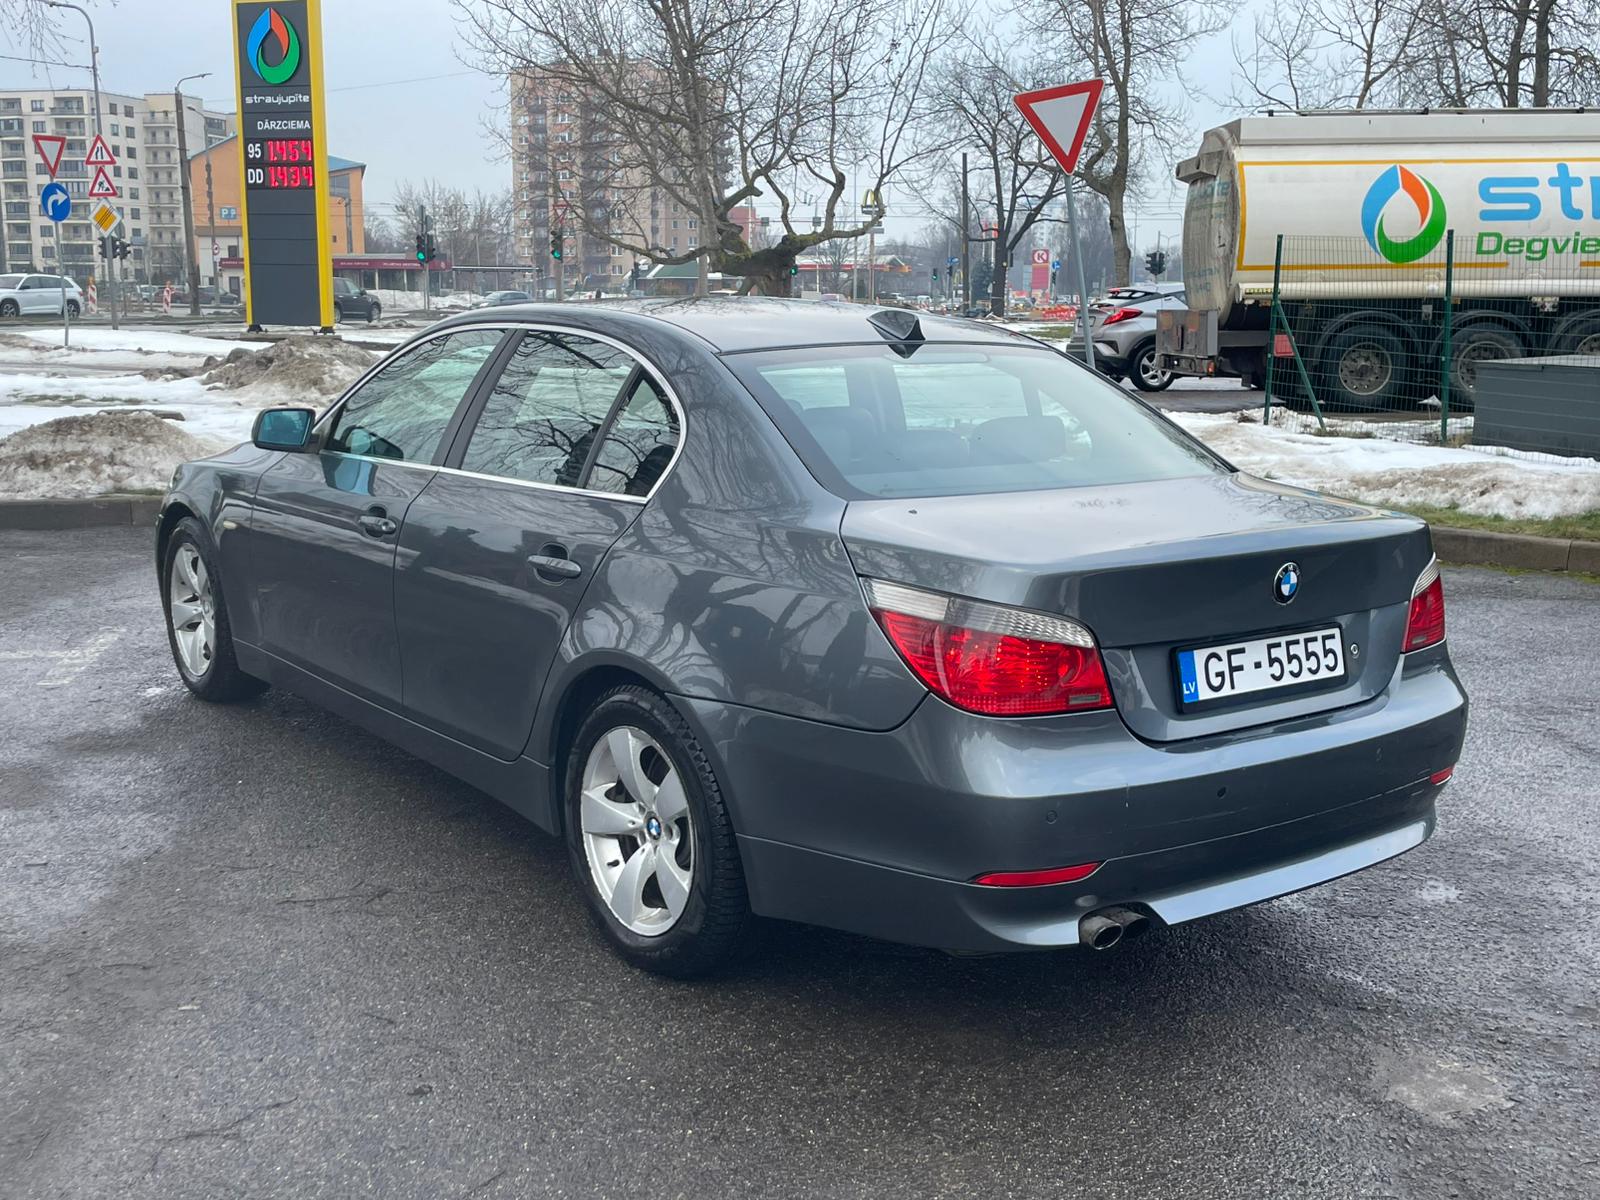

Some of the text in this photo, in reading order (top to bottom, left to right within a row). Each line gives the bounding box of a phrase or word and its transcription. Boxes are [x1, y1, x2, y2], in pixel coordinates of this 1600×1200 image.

[245, 93, 310, 105] straujupīte
[257, 119, 311, 130] DĀRZCIEMA
[247, 140, 312, 161] 95 1.454
[247, 168, 264, 184] DD
[1183, 682, 1196, 694] LV
